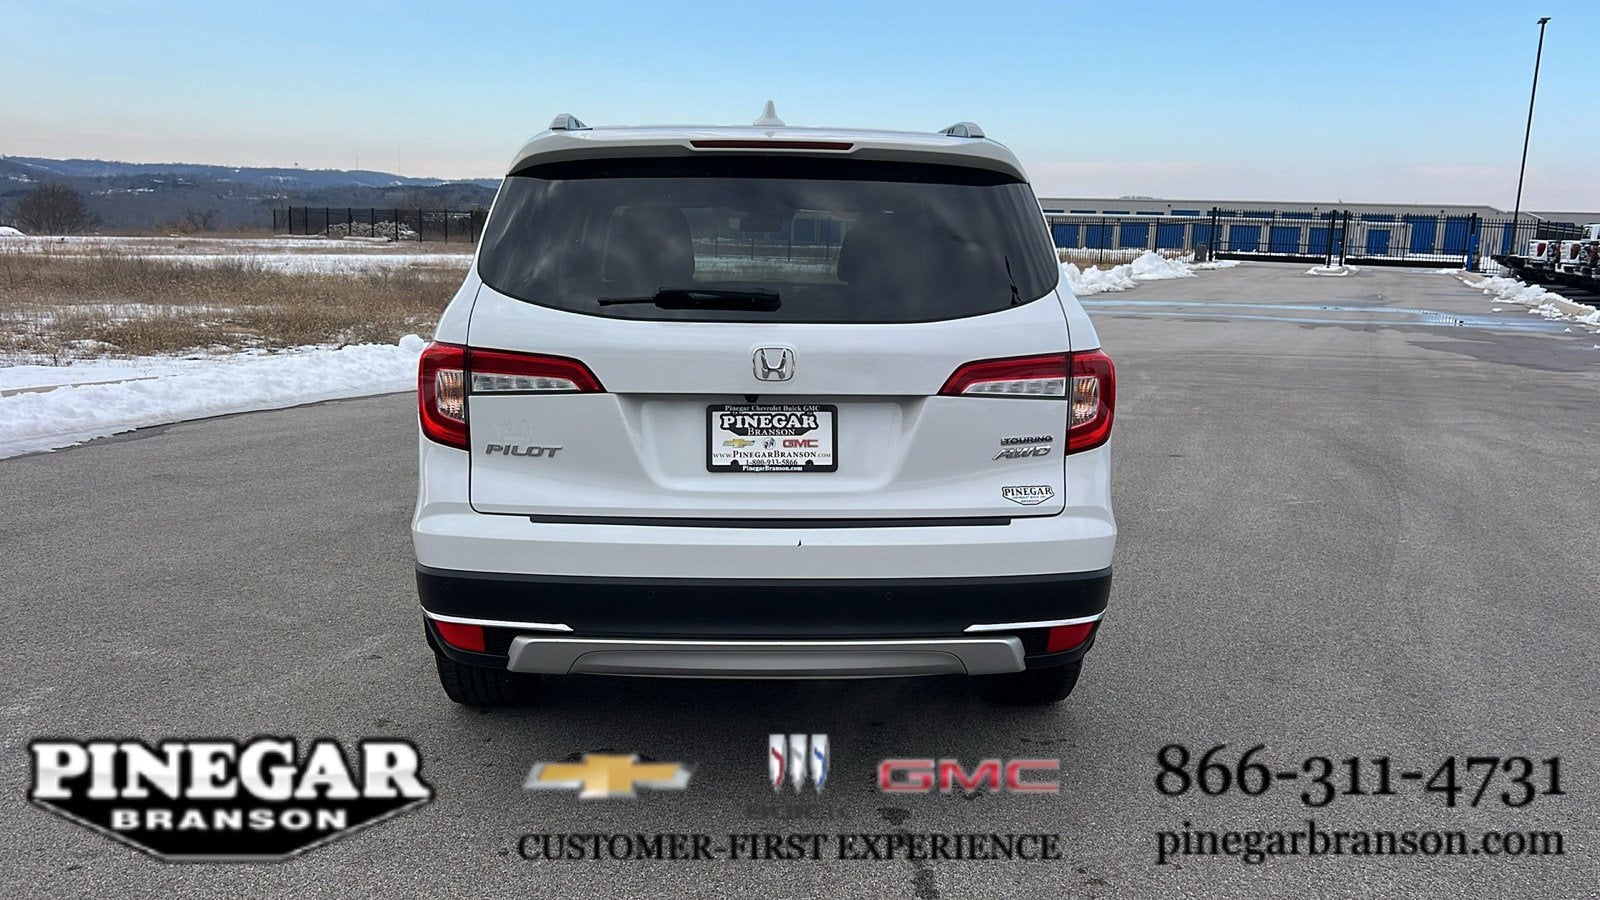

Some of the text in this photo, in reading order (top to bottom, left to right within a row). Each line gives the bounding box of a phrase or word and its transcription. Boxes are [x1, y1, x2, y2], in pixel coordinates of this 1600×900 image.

[722, 415, 818, 428] PINEGAR
[747, 428, 795, 436] BRANSON
[782, 439, 819, 448] GMC
[1001, 435, 1053, 445] TOURING
[485, 443, 563, 458] PILOT
[992, 445, 1051, 460] AWD
[742, 465, 803, 473] PinegarBranson.com
[1004, 487, 1052, 496] PINEGAR
